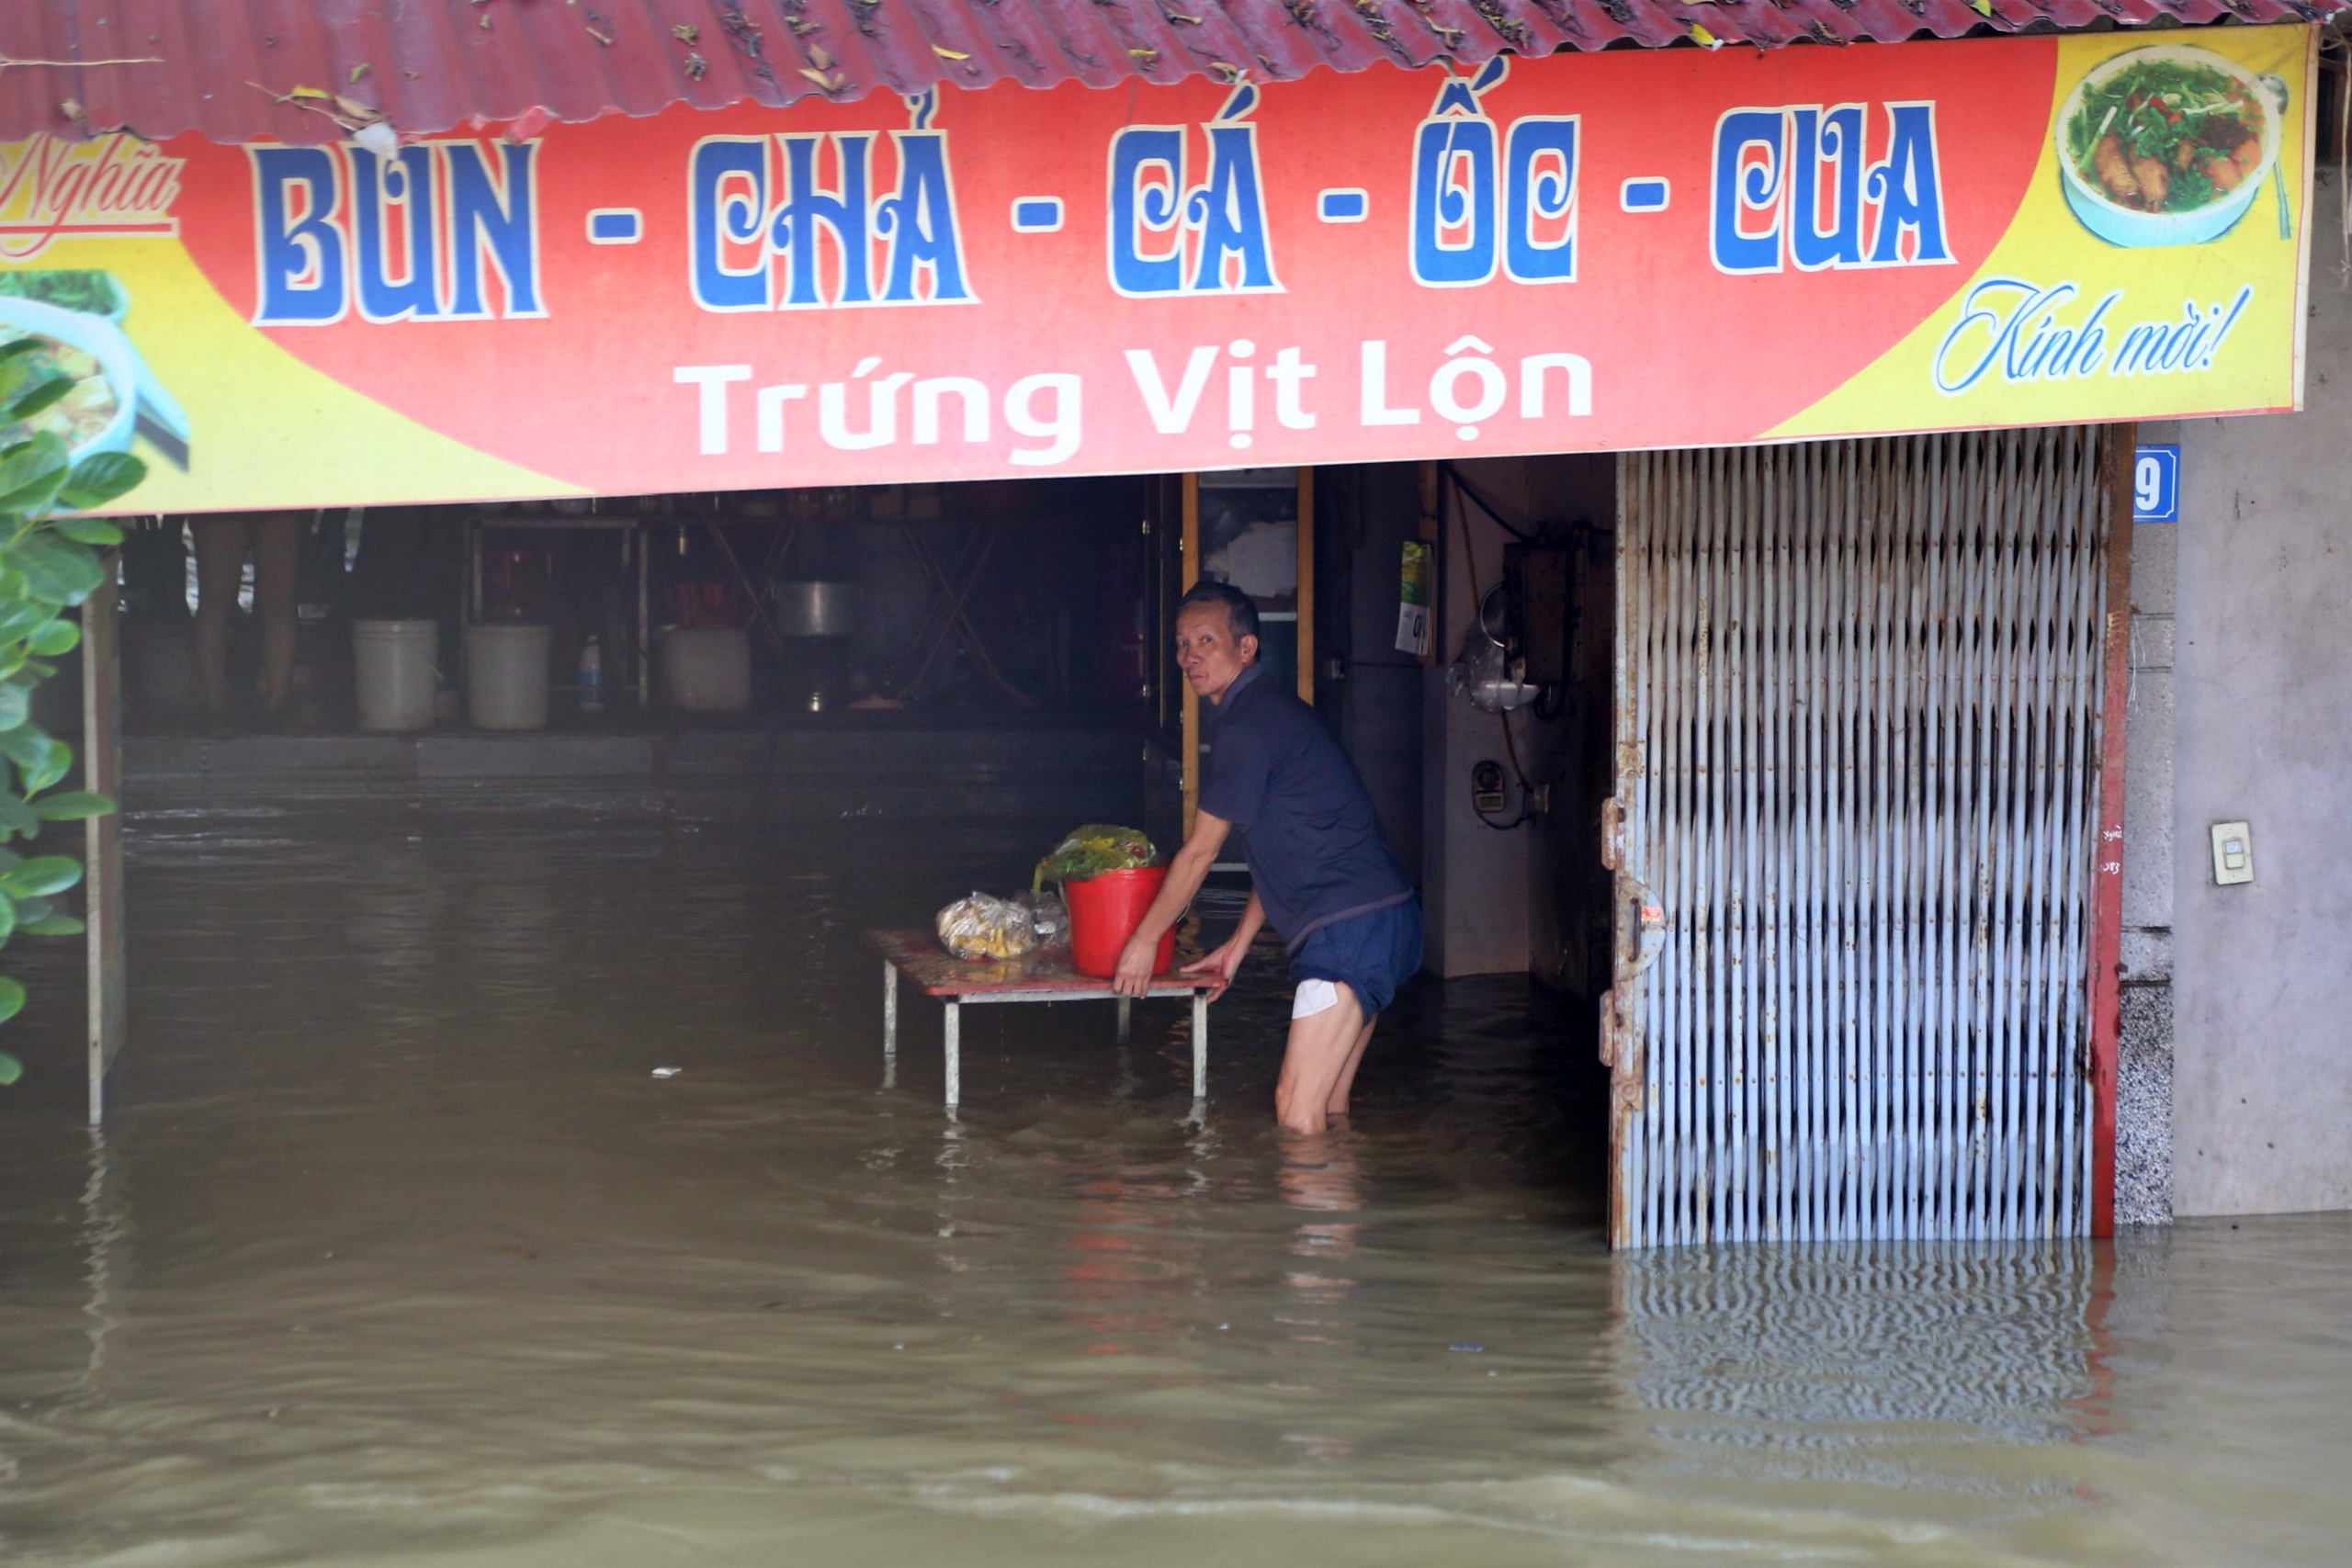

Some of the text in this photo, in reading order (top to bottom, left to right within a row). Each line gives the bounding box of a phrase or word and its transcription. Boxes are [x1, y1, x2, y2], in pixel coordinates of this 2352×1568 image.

[689, 84, 981, 312] CHẢ
[1108, 83, 1286, 298] CÁ
[1409, 55, 1581, 288] ỐC
[1711, 100, 1958, 274] CUA
[1932, 276, 2253, 395] Kính mời!
[673, 336, 1591, 467] Trứng Vịt Lộn
[2134, 457, 2161, 511] 9
